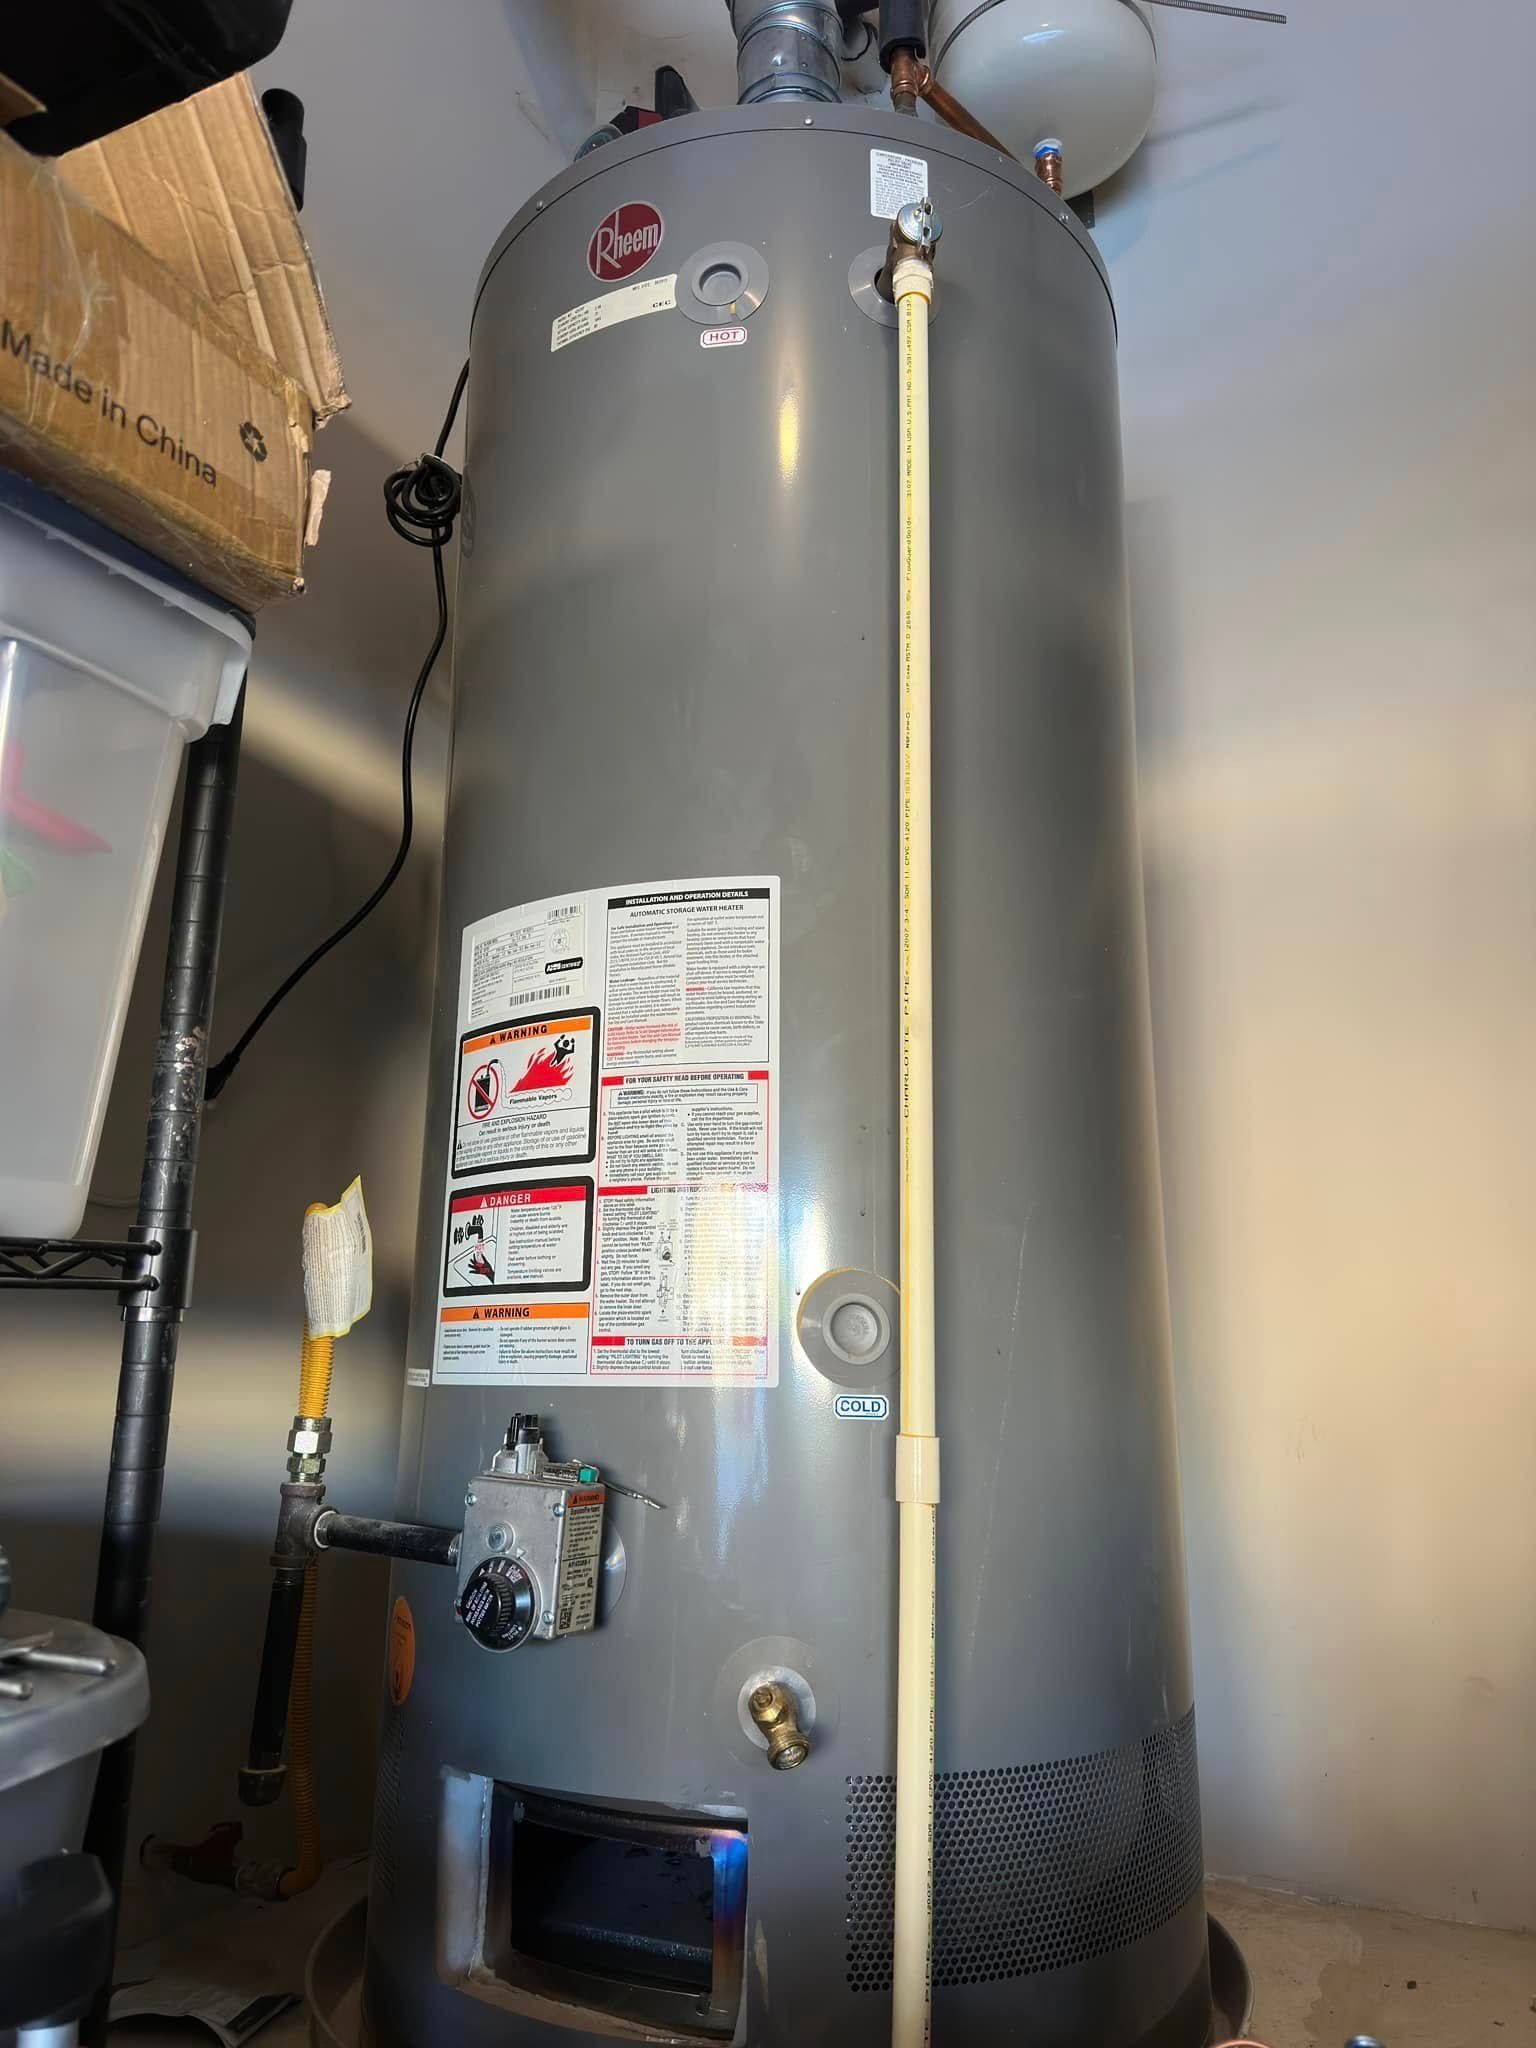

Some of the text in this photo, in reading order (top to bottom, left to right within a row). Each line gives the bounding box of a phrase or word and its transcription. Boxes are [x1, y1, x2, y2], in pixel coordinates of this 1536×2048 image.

[596, 211, 659, 274] Rheem
[652, 299, 671, 308] CEC
[709, 332, 738, 342] HOT
[2, 320, 217, 488] Made in China
[625, 896, 669, 905] INSTALLATION
[669, 894, 684, 902] AND
[685, 892, 721, 900] OPERATION
[630, 909, 665, 917] AUTOMATIC
[666, 906, 696, 914] STORAGE
[499, 1025, 547, 1041] WARNING
[509, 1093, 557, 1105] Flammable Vapors
[501, 1117, 525, 1126] EXPLOSION
[502, 1125, 517, 1133] serious
[490, 1193, 531, 1206] DANGER
[484, 1307, 530, 1318] WARNING
[841, 1400, 881, 1412] COLD
